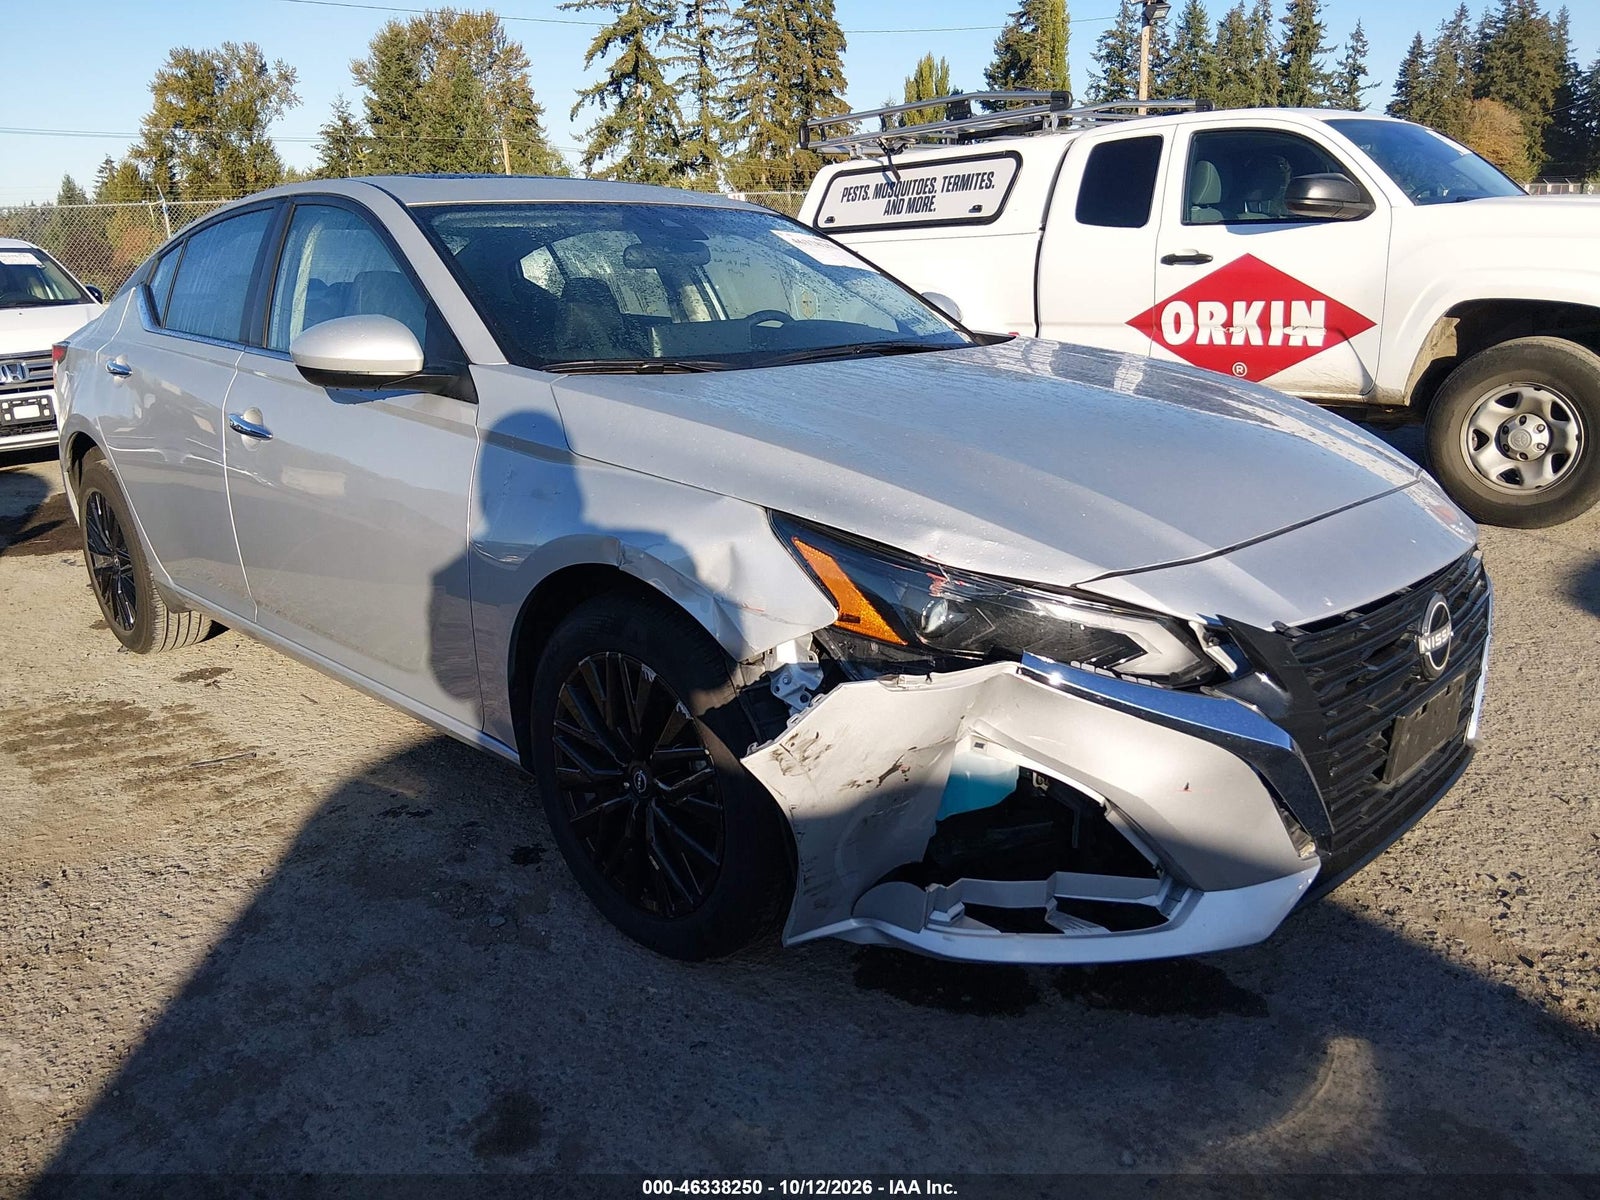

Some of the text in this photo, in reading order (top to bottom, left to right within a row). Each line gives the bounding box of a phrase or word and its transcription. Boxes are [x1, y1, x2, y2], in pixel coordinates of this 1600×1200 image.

[841, 171, 995, 203] PESTS. MOSQUITOES. TERMITES.
[883, 195, 936, 216] AND MORE.
[1160, 300, 1326, 347] ORKIN
